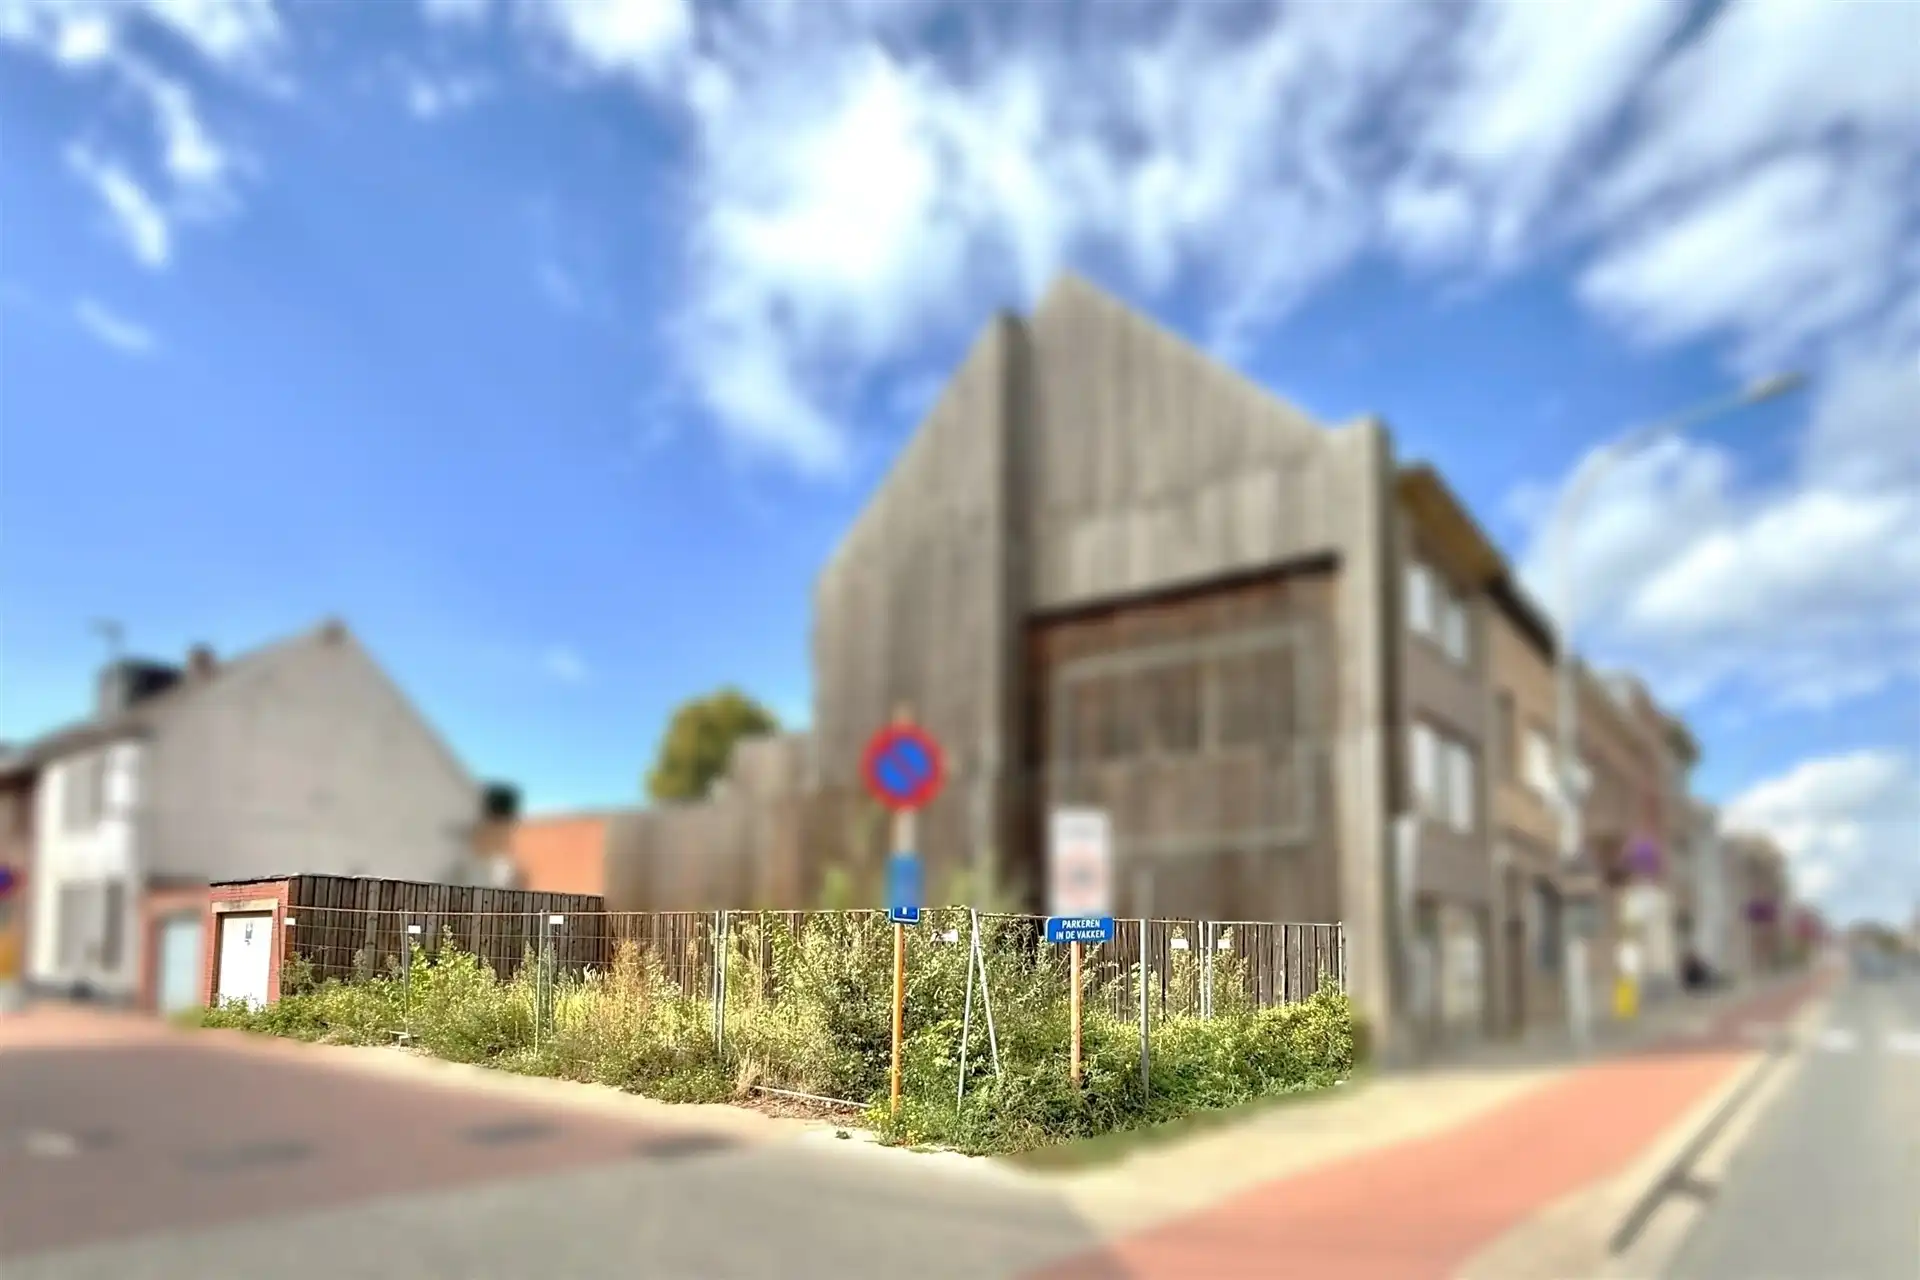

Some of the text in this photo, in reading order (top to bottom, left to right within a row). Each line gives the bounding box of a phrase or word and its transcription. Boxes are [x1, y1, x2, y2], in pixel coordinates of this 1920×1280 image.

[1061, 919, 1101, 929] PARKEREN
[1055, 929, 1106, 940] IN DE VAKKEN
